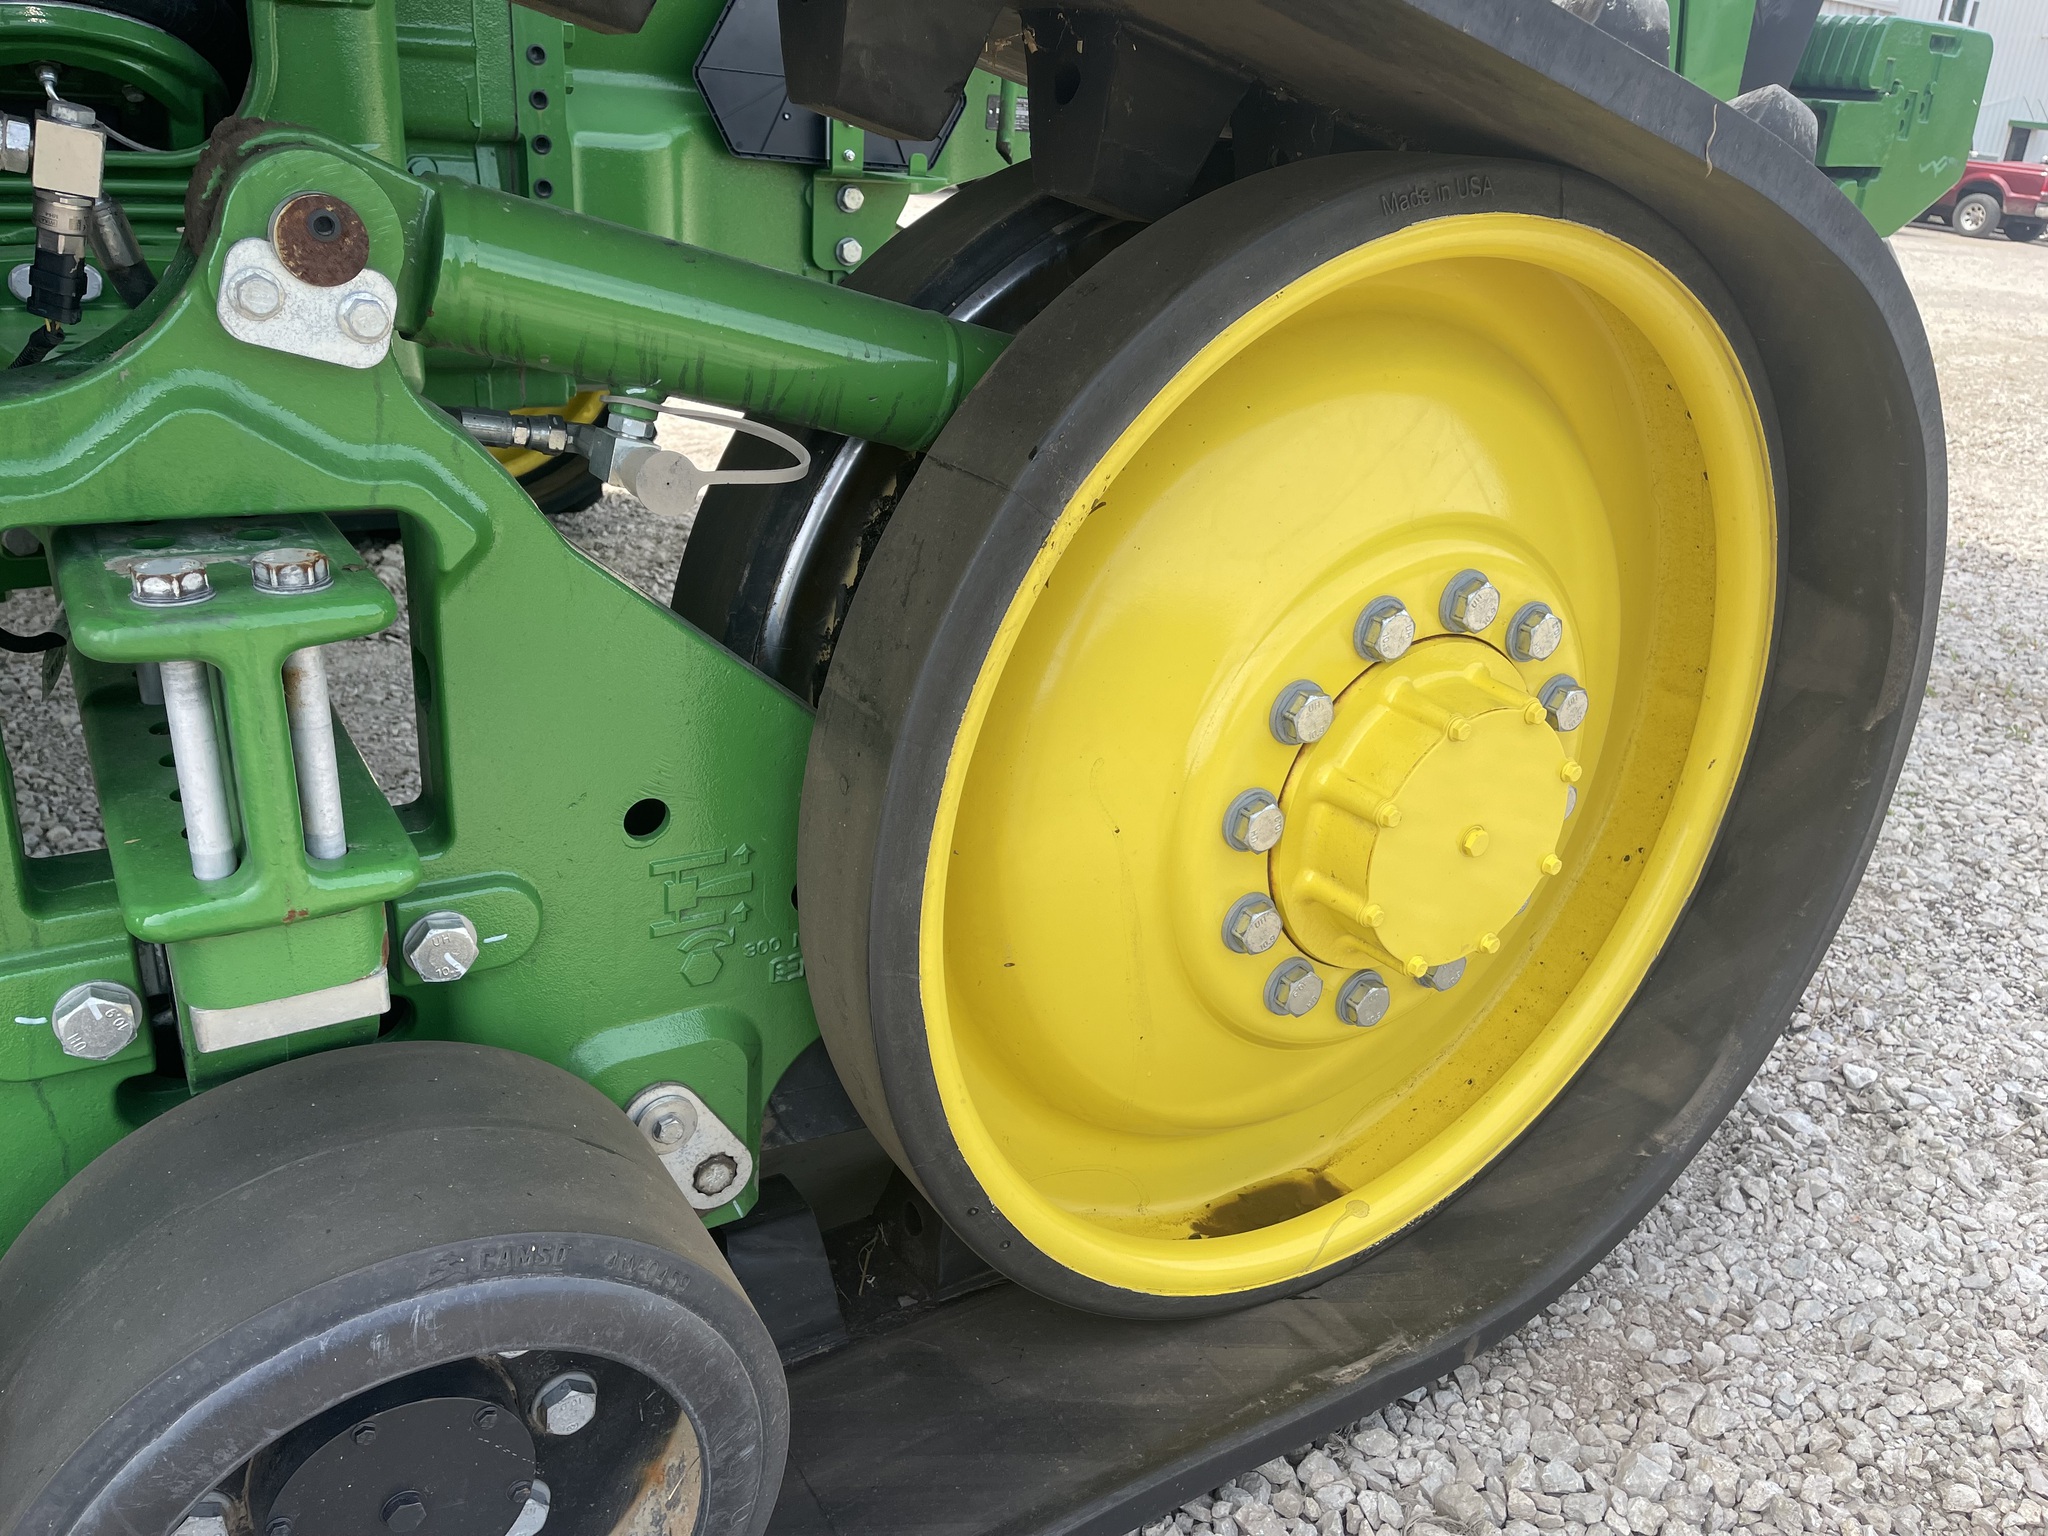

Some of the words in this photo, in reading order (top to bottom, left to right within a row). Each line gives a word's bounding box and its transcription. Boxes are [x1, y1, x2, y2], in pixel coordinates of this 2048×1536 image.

[1380, 185, 1432, 216] Made
[1435, 180, 1452, 202] in
[1455, 175, 1496, 199] USA
[431, 932, 451, 947] UH
[743, 936, 782, 958] 300
[104, 1007, 129, 1031] 10.9
